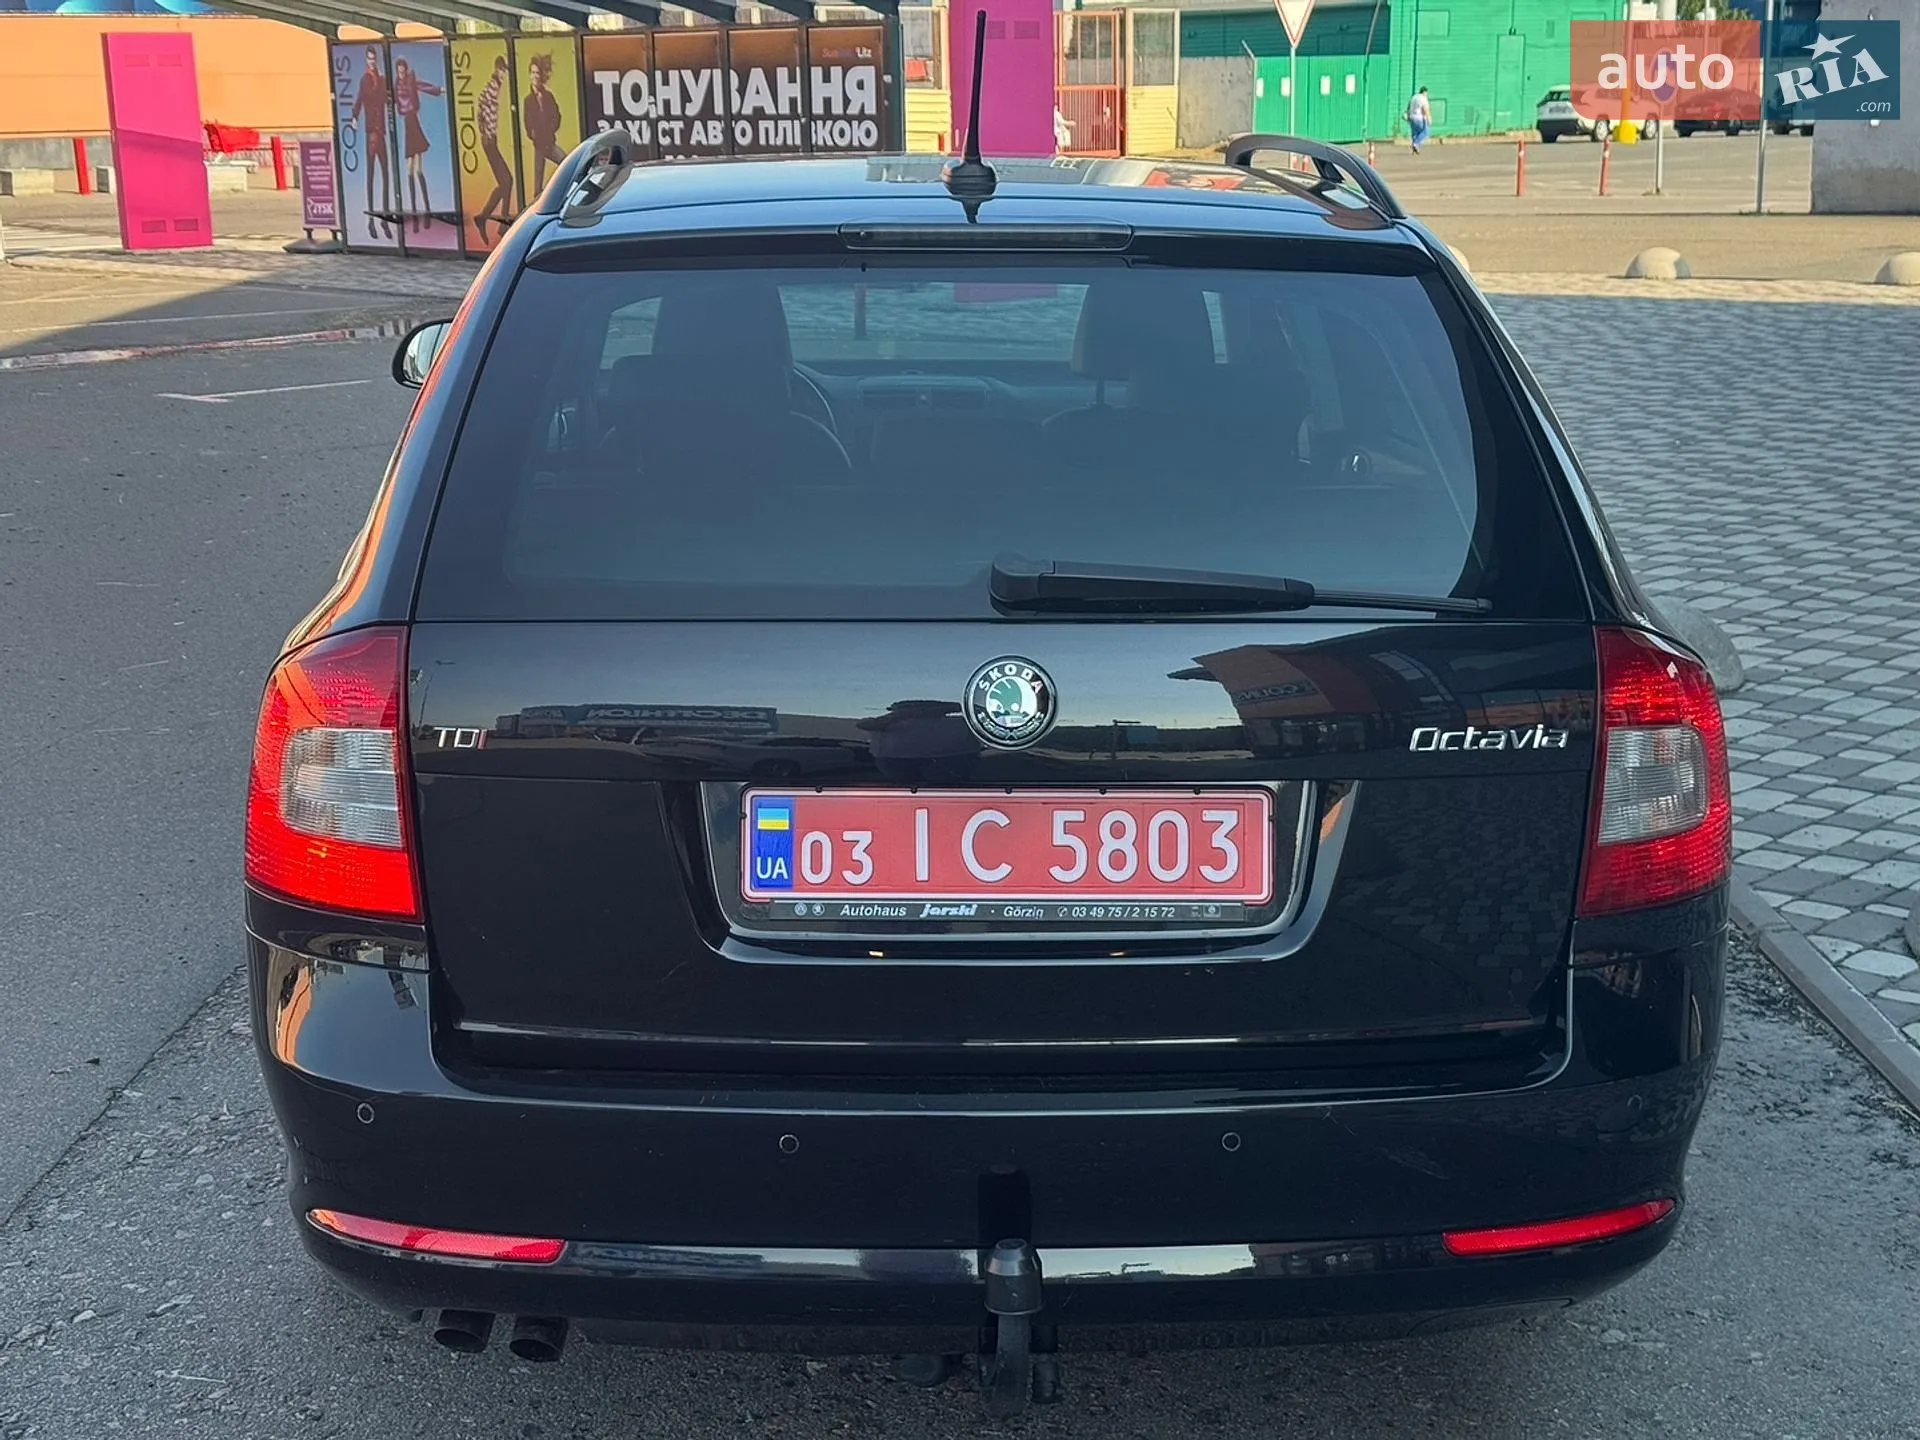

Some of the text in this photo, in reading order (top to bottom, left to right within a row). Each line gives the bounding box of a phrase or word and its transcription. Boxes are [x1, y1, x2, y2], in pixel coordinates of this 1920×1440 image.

[334, 54, 359, 173] COLIN'S
[453, 50, 479, 174] COLIN'S
[433, 726, 488, 750] TDI
[1409, 723, 1569, 752] Octavia
[801, 830, 874, 885] 03
[1048, 809, 1240, 884] 5803
[756, 857, 789, 880] UA
[840, 904, 907, 917] Autohaus
